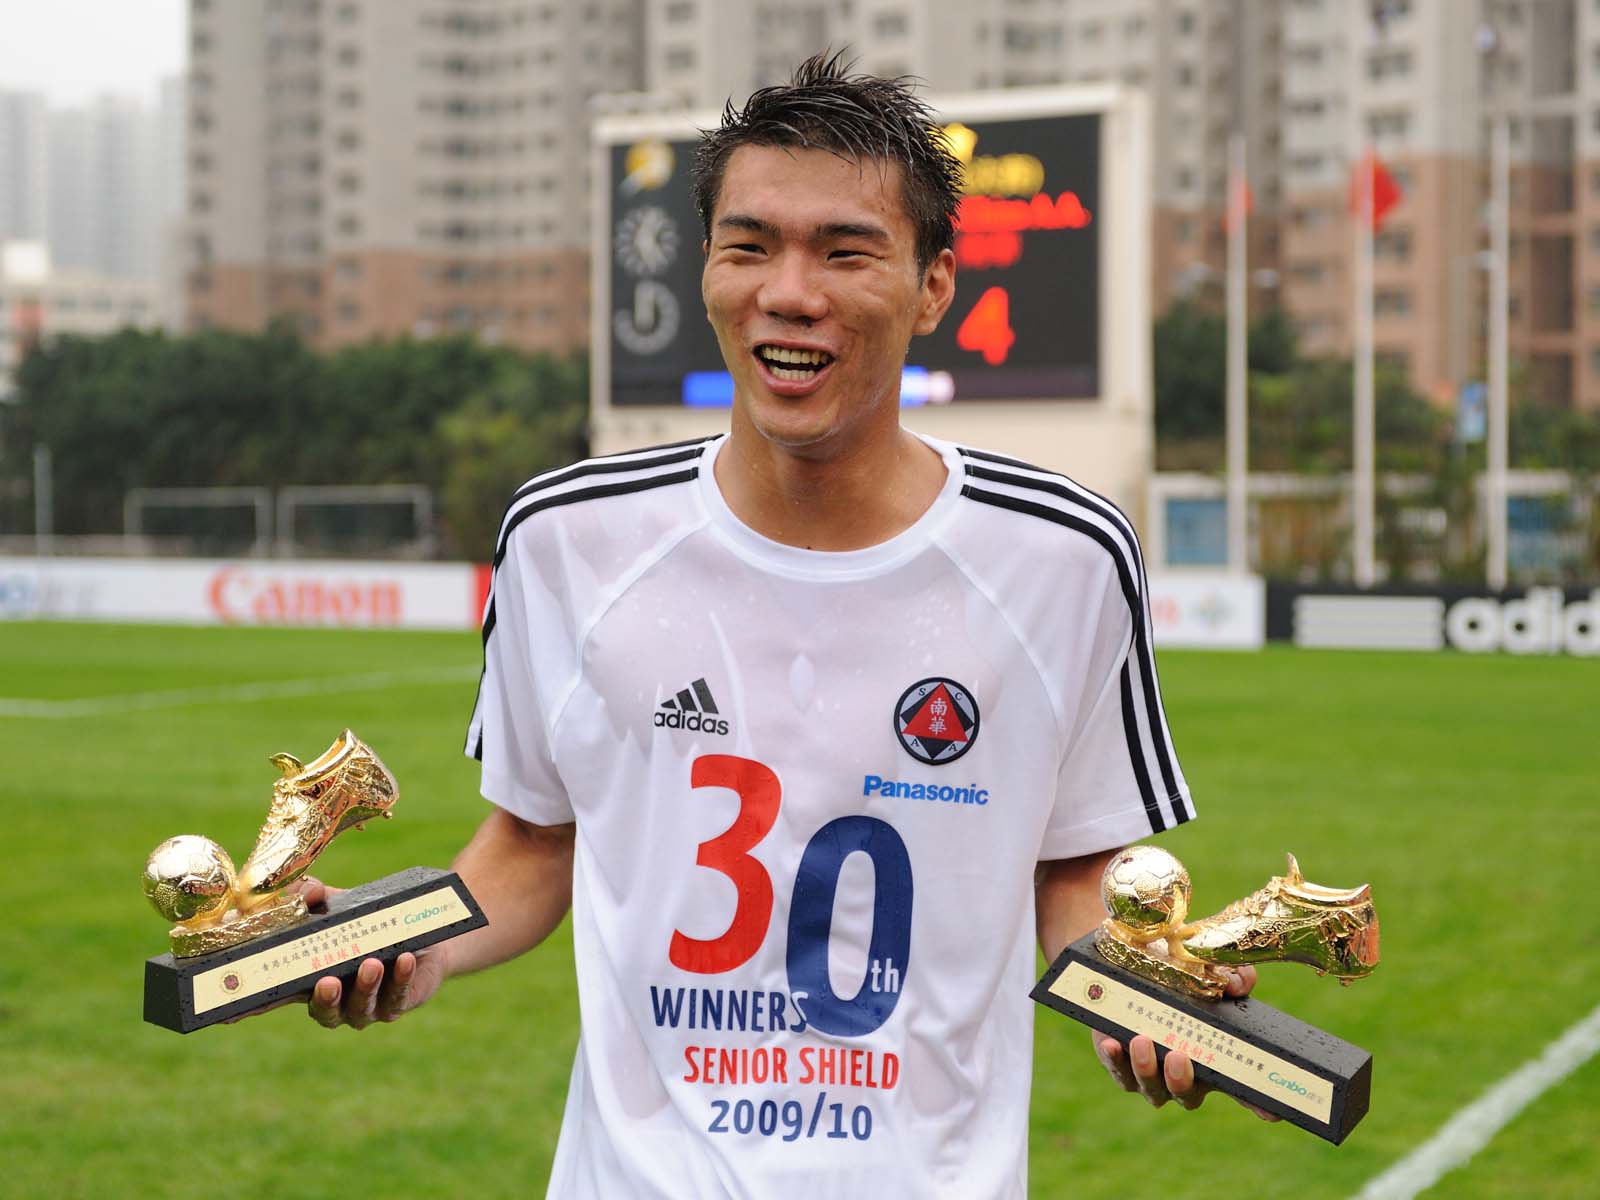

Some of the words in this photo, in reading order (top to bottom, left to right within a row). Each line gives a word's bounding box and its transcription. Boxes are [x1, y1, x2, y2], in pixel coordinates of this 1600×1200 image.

[957, 286, 1015, 366] 4
[208, 564, 402, 625] Canon
[654, 709, 729, 736] adidas
[863, 775, 989, 805] Panasonic
[650, 986, 809, 1033] WINNERS
[683, 1045, 788, 1085] SENIOR
[798, 1047, 900, 1090] SHIELD
[708, 1091, 873, 1142] 2009/10
